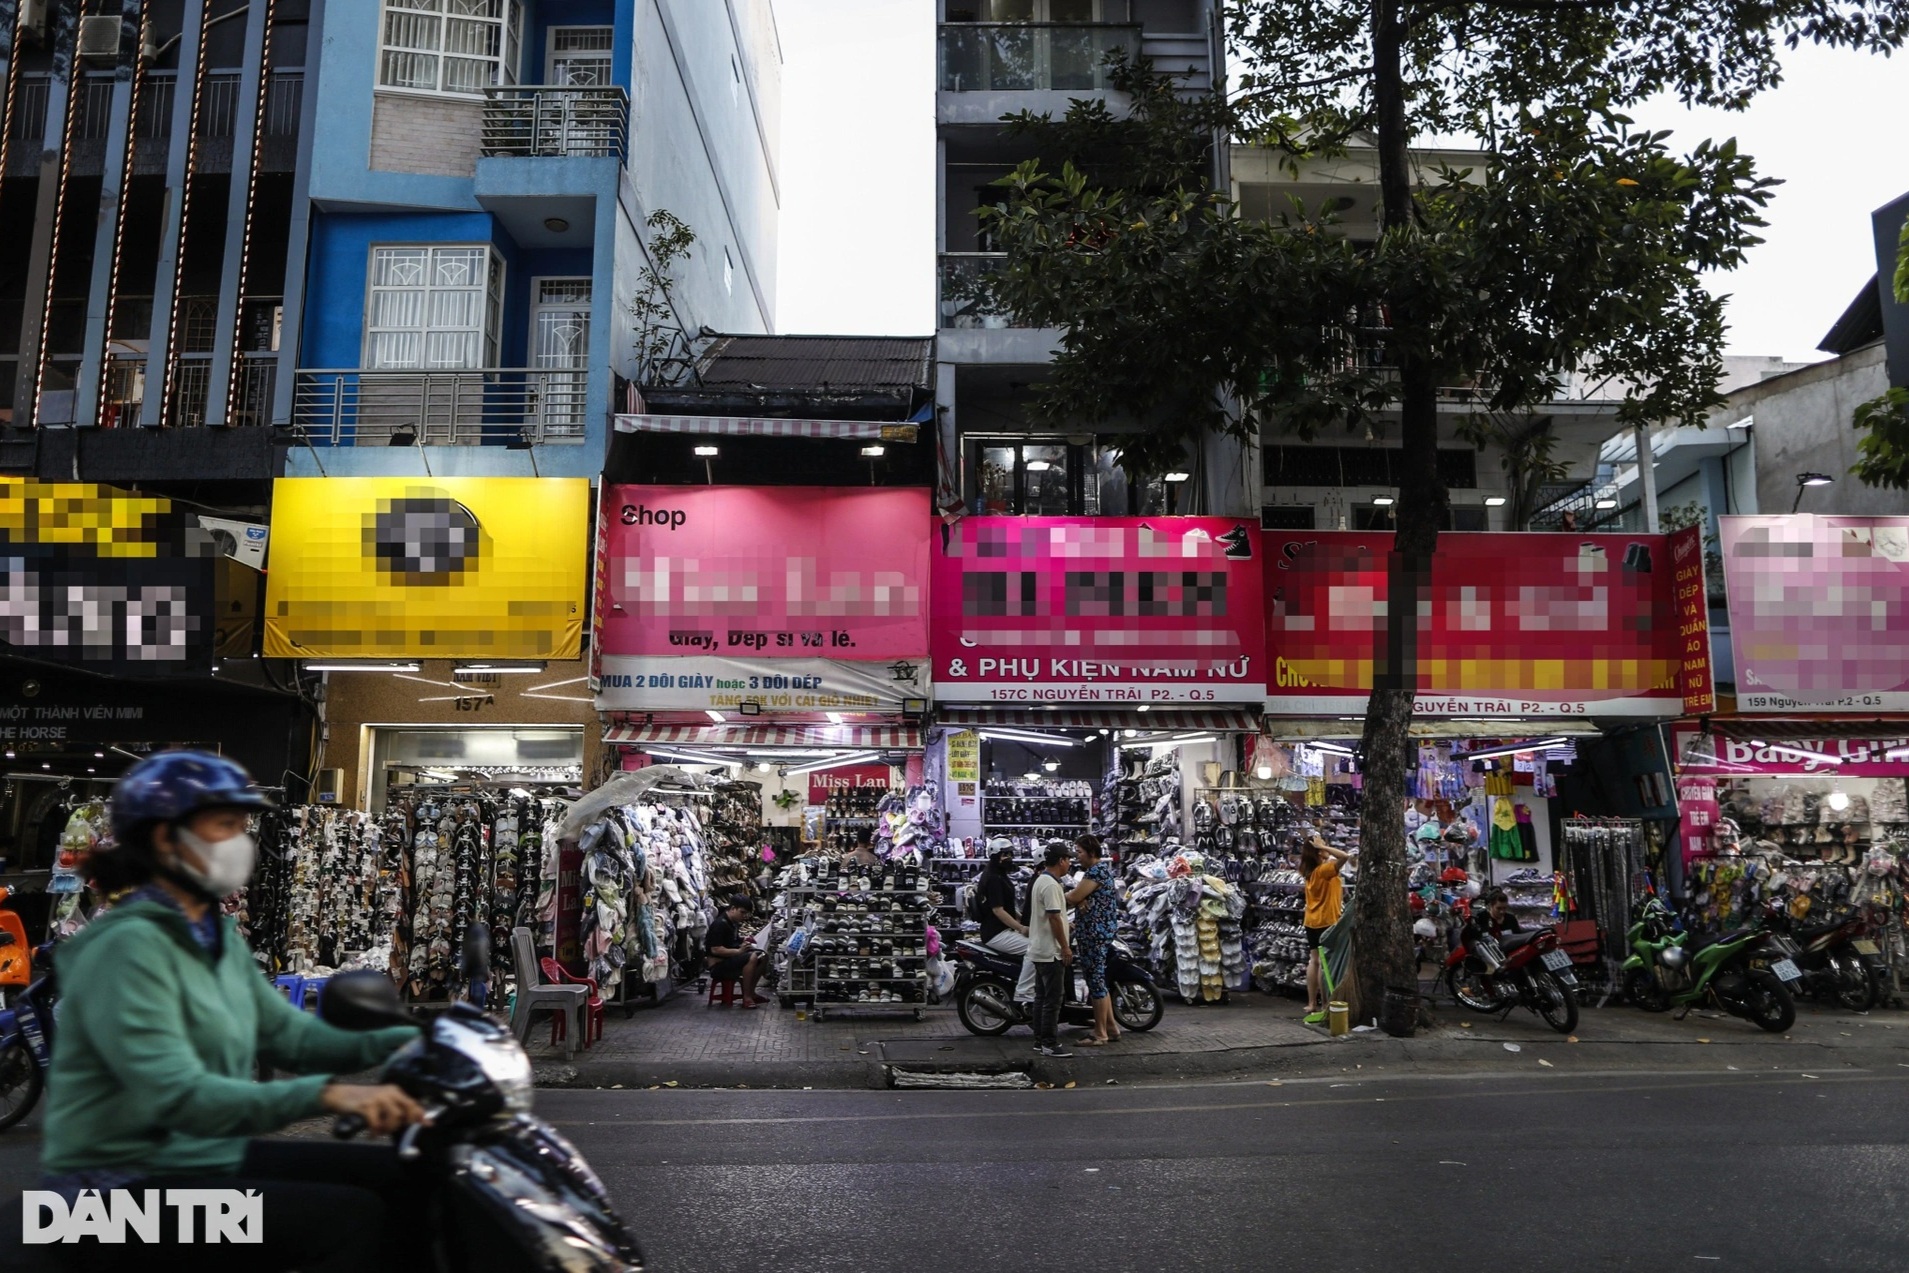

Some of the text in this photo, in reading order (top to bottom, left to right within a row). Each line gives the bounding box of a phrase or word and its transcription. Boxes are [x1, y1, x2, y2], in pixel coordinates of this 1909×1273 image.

[620, 505, 686, 530] Shop
[1676, 565, 1698, 582] GIÀY
[1684, 602, 1697, 616] VÀ
[948, 658, 968, 677] &
[979, 658, 1040, 681] PHỤ
[1684, 657, 1706, 671] NAM
[601, 674, 632, 688] MUA
[636, 675, 645, 688] 2
[649, 672, 675, 688] ĐÔI
[678, 672, 714, 688] GIÀY
[716, 678, 746, 691] hoặc
[749, 676, 758, 689] 3
[763, 674, 788, 689] ĐÔI
[792, 673, 823, 689] DÉP
[991, 689, 1028, 700] 157C
[1033, 684, 1100, 700] NGUYỄN
[1105, 686, 1142, 700] TRÃI
[1151, 689, 1175, 700] P2.
[1189, 689, 1215, 701] Q.5
[1474, 700, 1511, 713] TRÃI
[1521, 703, 1545, 713] P2.
[1560, 703, 1585, 714] Q.5
[1748, 697, 1767, 707] 159
[1863, 696, 1882, 706] Q.5
[34, 704, 79, 719] THÀNH
[83, 704, 115, 719] VIÊN
[19, 727, 67, 739] HORSE
[812, 774, 887, 788] Miss Lan
